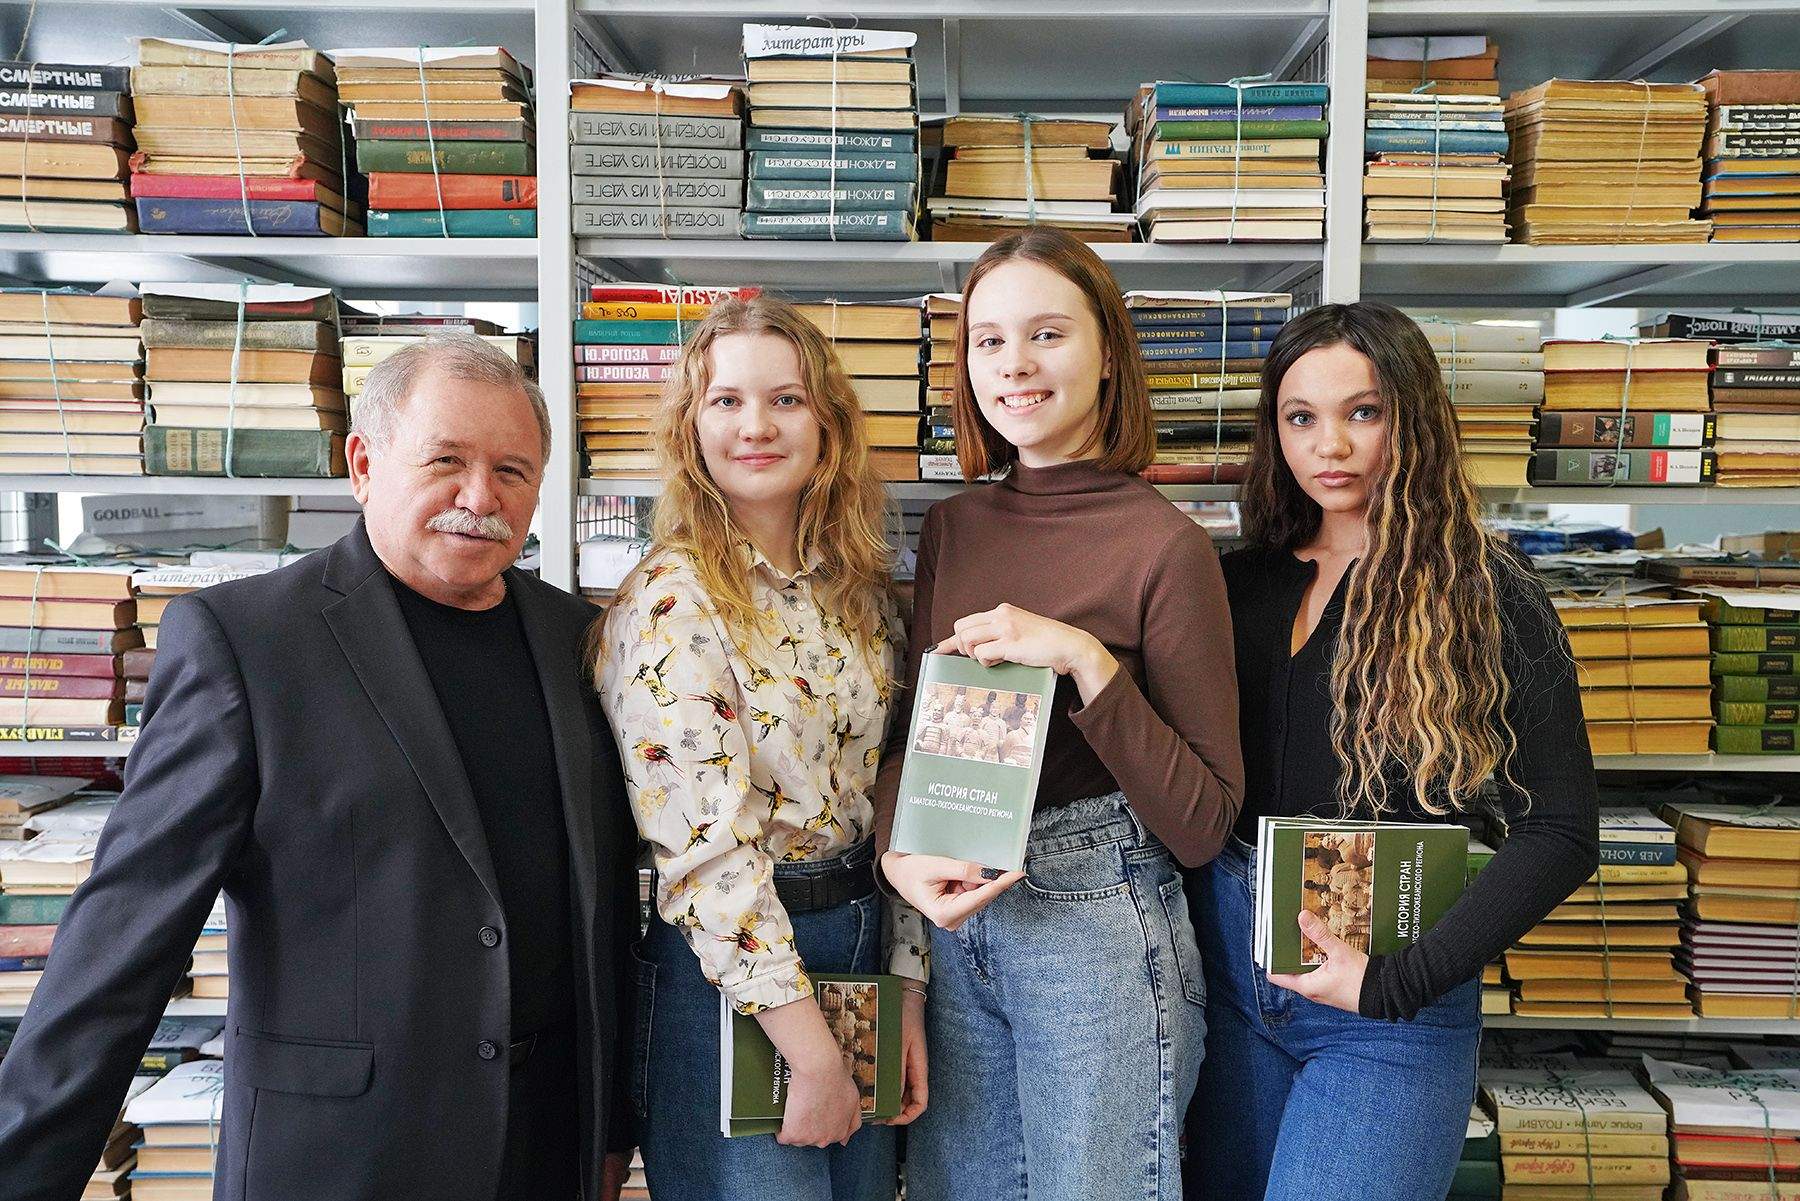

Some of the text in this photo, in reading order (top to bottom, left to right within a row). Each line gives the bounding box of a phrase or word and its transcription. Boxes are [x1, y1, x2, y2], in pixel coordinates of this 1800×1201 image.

[761, 34, 866, 53] литературы
[0, 67, 103, 87] СМЕРТНЫЕ
[0, 91, 95, 110] СМЕРТНЫЕ
[0, 117, 93, 136] СМЕРТНЫЕ
[584, 121, 725, 138] ПОСЛЕДНИЙ ИЗ УДЭГЕ
[844, 135, 881, 147] ДЖОН
[585, 153, 727, 170] ПОСЛЕДНИЙ ИЗ УДЭГЕ
[849, 159, 886, 169] ДЖОН
[585, 182, 726, 199] ПОСЛЕДНИЙ ИЗ УДЭГЕ
[847, 189, 884, 200] ДЖОН
[585, 212, 725, 227] ПОСЛЕДНИЙ ИЗ УДЭГЕ
[757, 215, 839, 225] ОЛСУОРСИ
[839, 214, 877, 225] ДЖОН
[1695, 321, 1800, 335] АМЕННЫЙ ПОЯС
[93, 507, 161, 522] GOLDBALL
[928, 782, 999, 804] ИСТОРИЯ СТРАН
[908, 797, 1013, 820] АЗИАТСКО-ТИХООКЕАНСКОГО РЕГИОНА
[1397, 860, 1412, 938] ИСТОРИЯ СТРАН
[1411, 840, 1424, 944] ТСКО-ТИХООКЕАНСКОГО РЕГИОНА
[772, 1076, 782, 1105] РЕГИОНА
[1515, 1119, 1563, 1130] ПОДВИГ
[1610, 1121, 1643, 1131] Борис
